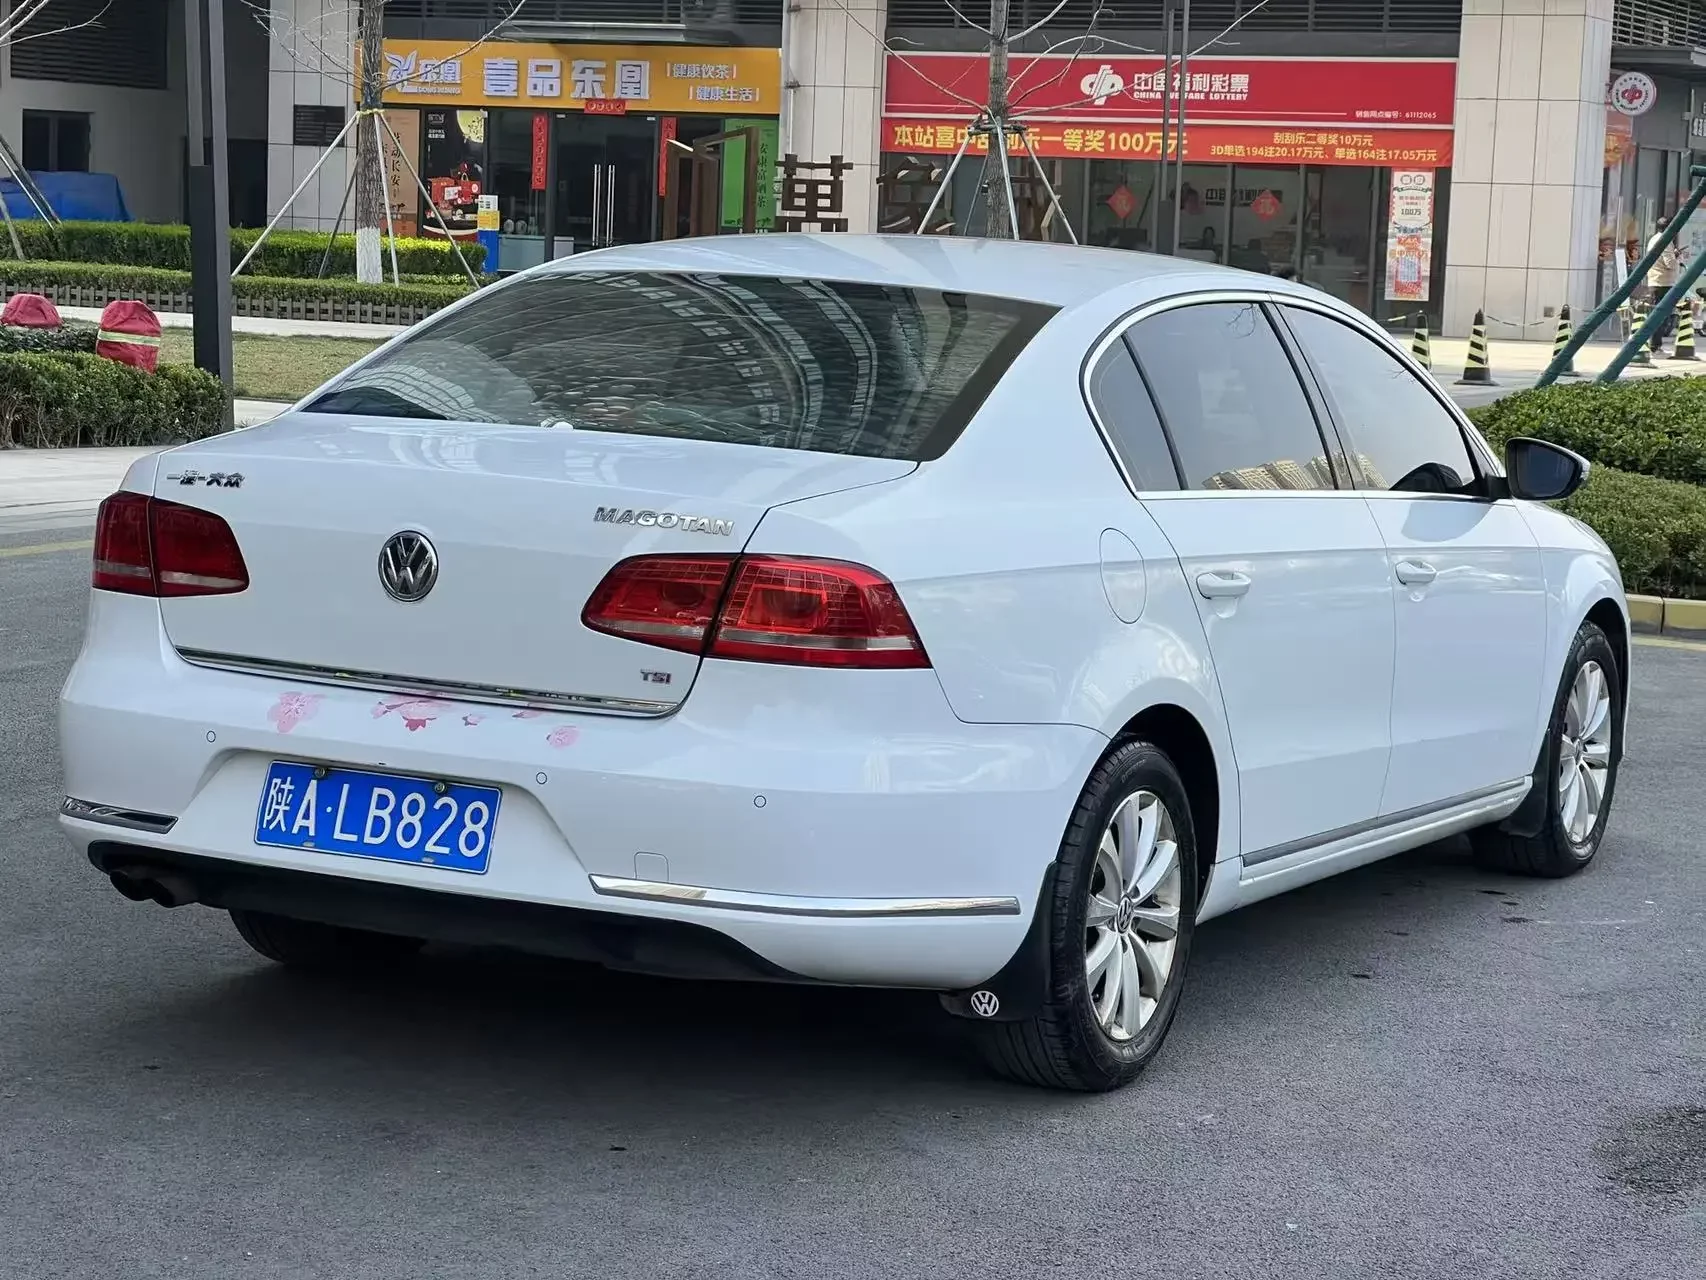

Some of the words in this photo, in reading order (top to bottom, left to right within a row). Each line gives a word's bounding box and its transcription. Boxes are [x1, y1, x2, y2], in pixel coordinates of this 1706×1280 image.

[483, 57, 650, 100] 壹品东凰
[672, 63, 731, 80] 健康饮茶
[1133, 73, 1250, 93] 中国福利彩票
[695, 86, 754, 102] 健康生活
[1133, 92, 1162, 100] CHINA
[1169, 92, 1206, 100] WEFARE
[1209, 93, 1249, 101] LOTTERY
[593, 506, 735, 537] MAGOTAN
[640, 670, 671, 685] TSI
[261, 775, 490, 859] 陕A·LB828
